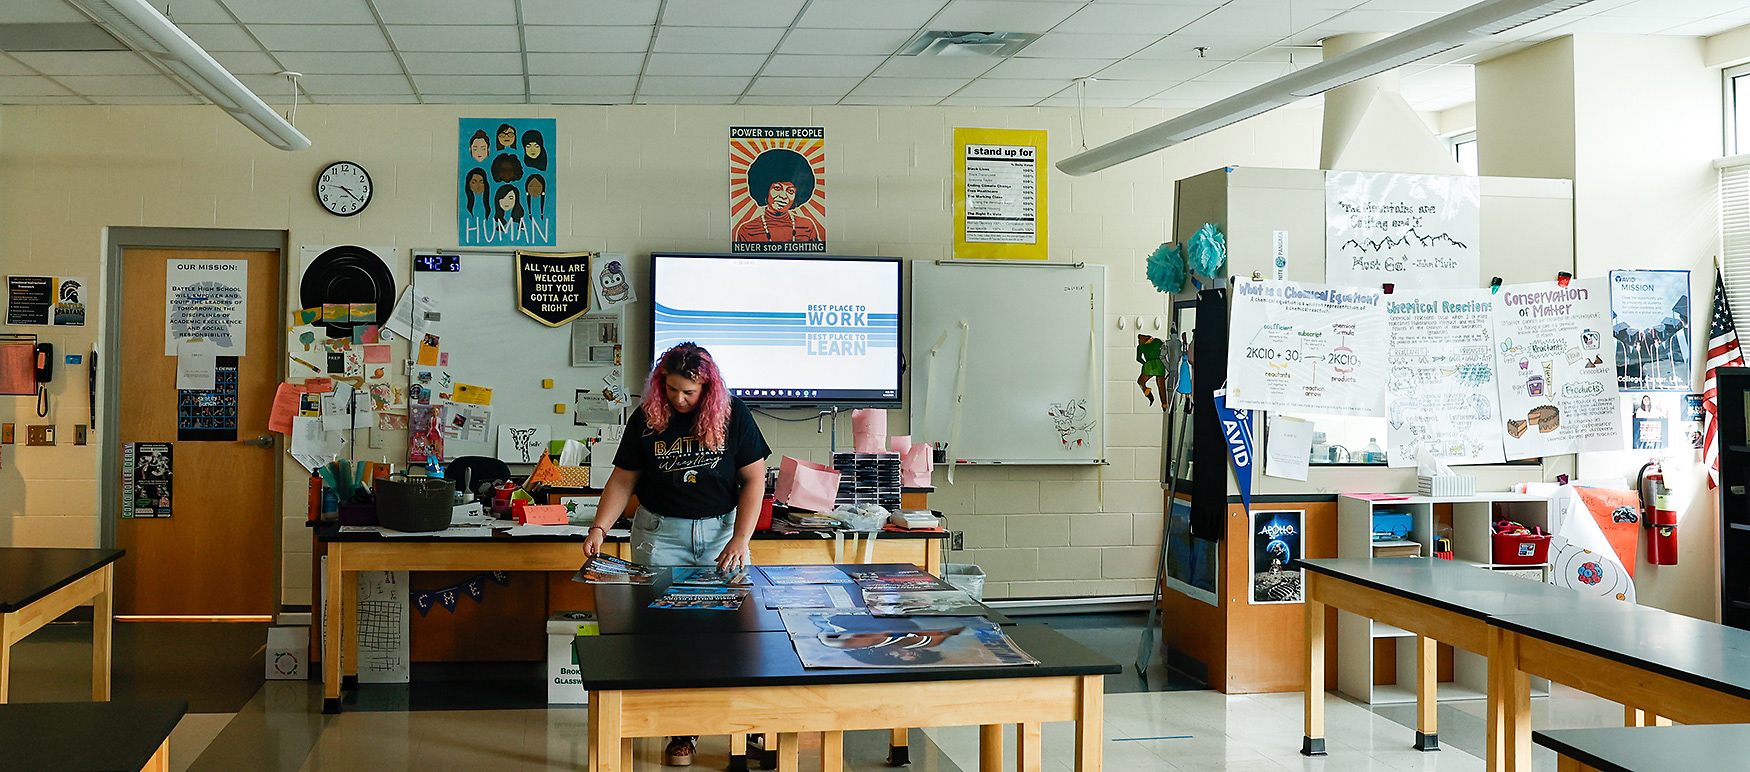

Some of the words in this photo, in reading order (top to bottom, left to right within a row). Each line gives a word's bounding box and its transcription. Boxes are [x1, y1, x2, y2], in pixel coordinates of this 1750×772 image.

[732, 128, 762, 137] POWER
[974, 147, 1002, 155] stand
[1418, 205, 1436, 214] are
[1392, 217, 1410, 227] and
[1412, 216, 1422, 227] I
[466, 216, 548, 244] HUMAN
[524, 263, 540, 271] ALL
[542, 264, 566, 272] Y'ALL
[568, 264, 586, 272] ARE
[534, 274, 576, 282] WELCOME
[536, 284, 554, 292] BUT
[1240, 282, 1263, 296] What
[1266, 286, 1274, 296] is
[1285, 286, 1328, 301] Chemical
[1330, 290, 1379, 306] Equation?
[531, 294, 559, 302] GOTTA
[1504, 287, 1589, 307] Conservation
[54, 308, 85, 316] SPARTANS
[541, 304, 568, 312] RIGHT
[1387, 299, 1437, 314] Chemical
[1442, 300, 1492, 313] Reactions
[1519, 307, 1529, 317] of
[1532, 304, 1572, 318] Matter
[807, 312, 866, 326] WORK
[808, 341, 866, 356] LEARN
[1565, 385, 1600, 394] Products
[655, 435, 726, 456] BATT
[1223, 420, 1250, 468] AVID
[124, 444, 132, 466] DERBY
[124, 469, 132, 494] ROLLER
[124, 497, 132, 516] COMO
[1258, 524, 1297, 535] APOLLO
